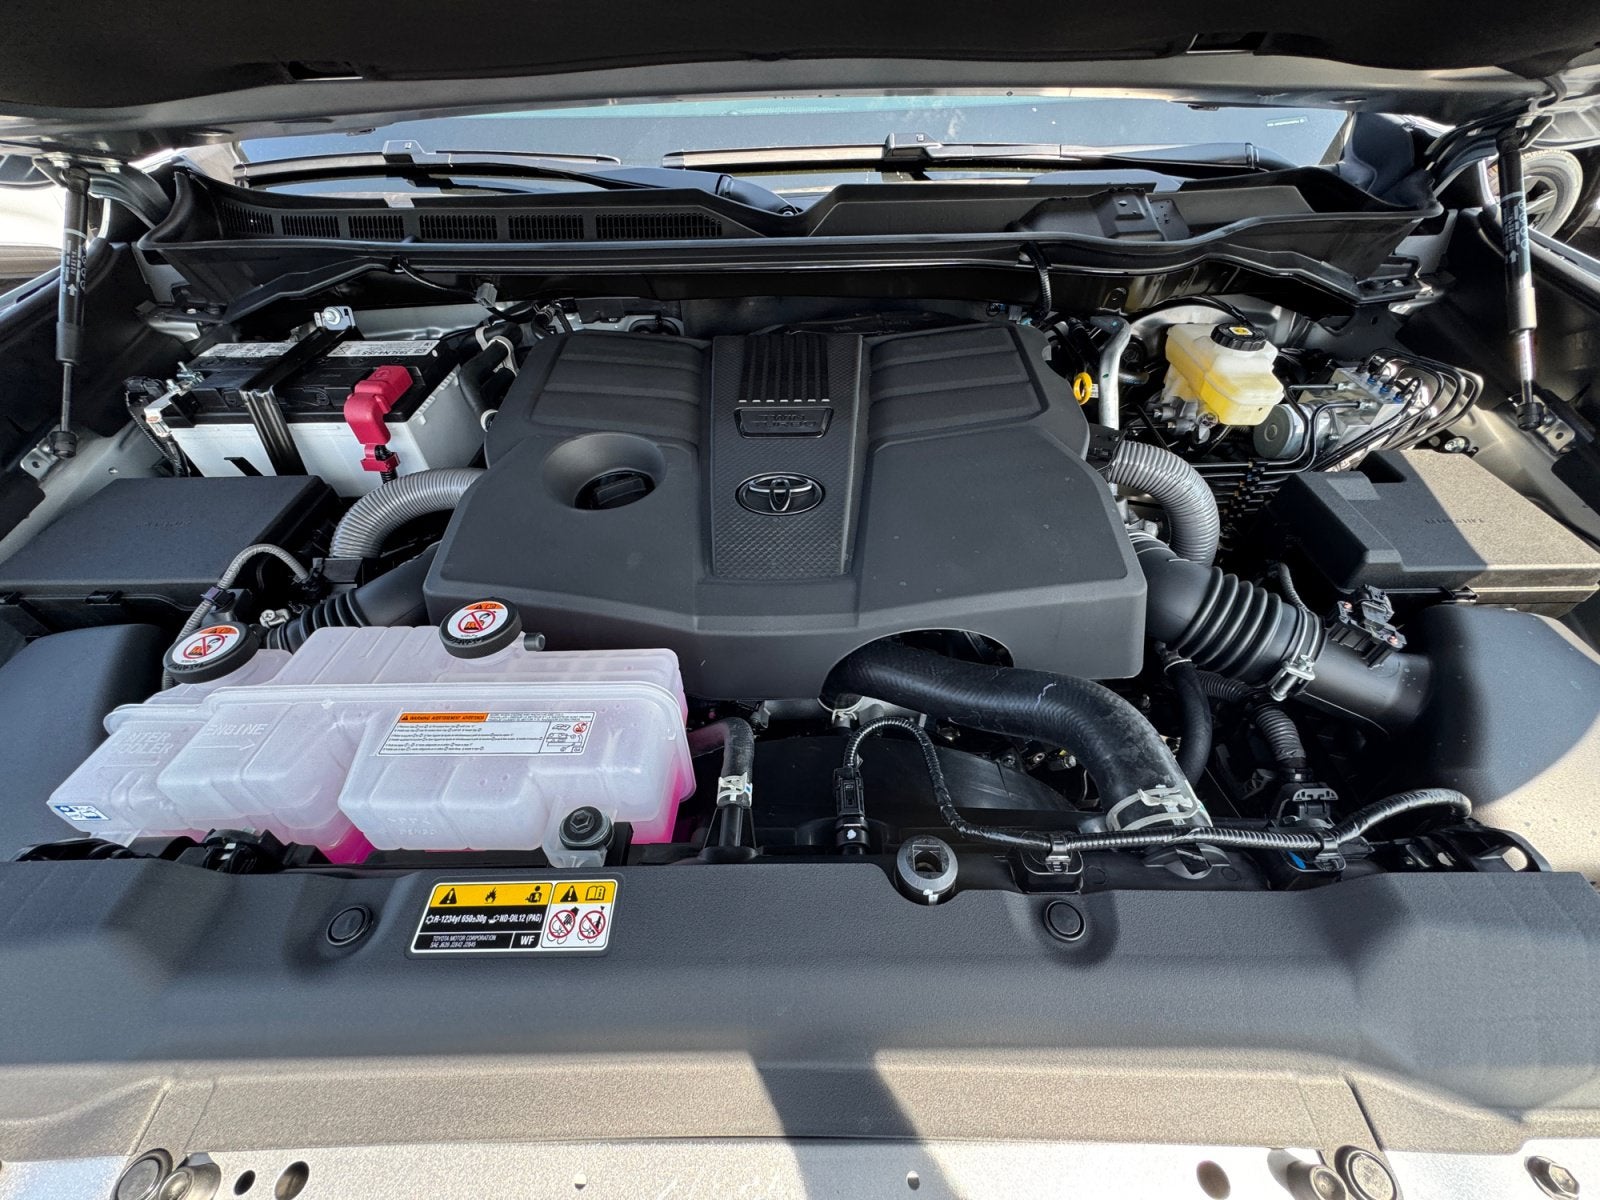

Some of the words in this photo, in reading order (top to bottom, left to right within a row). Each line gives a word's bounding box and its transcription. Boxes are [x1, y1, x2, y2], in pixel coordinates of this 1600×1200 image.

[200, 723, 269, 736] ENGINE
[433, 914, 462, 925] R-1234yf
[525, 913, 542, 924] (PAG)
[519, 935, 536, 946] WF
